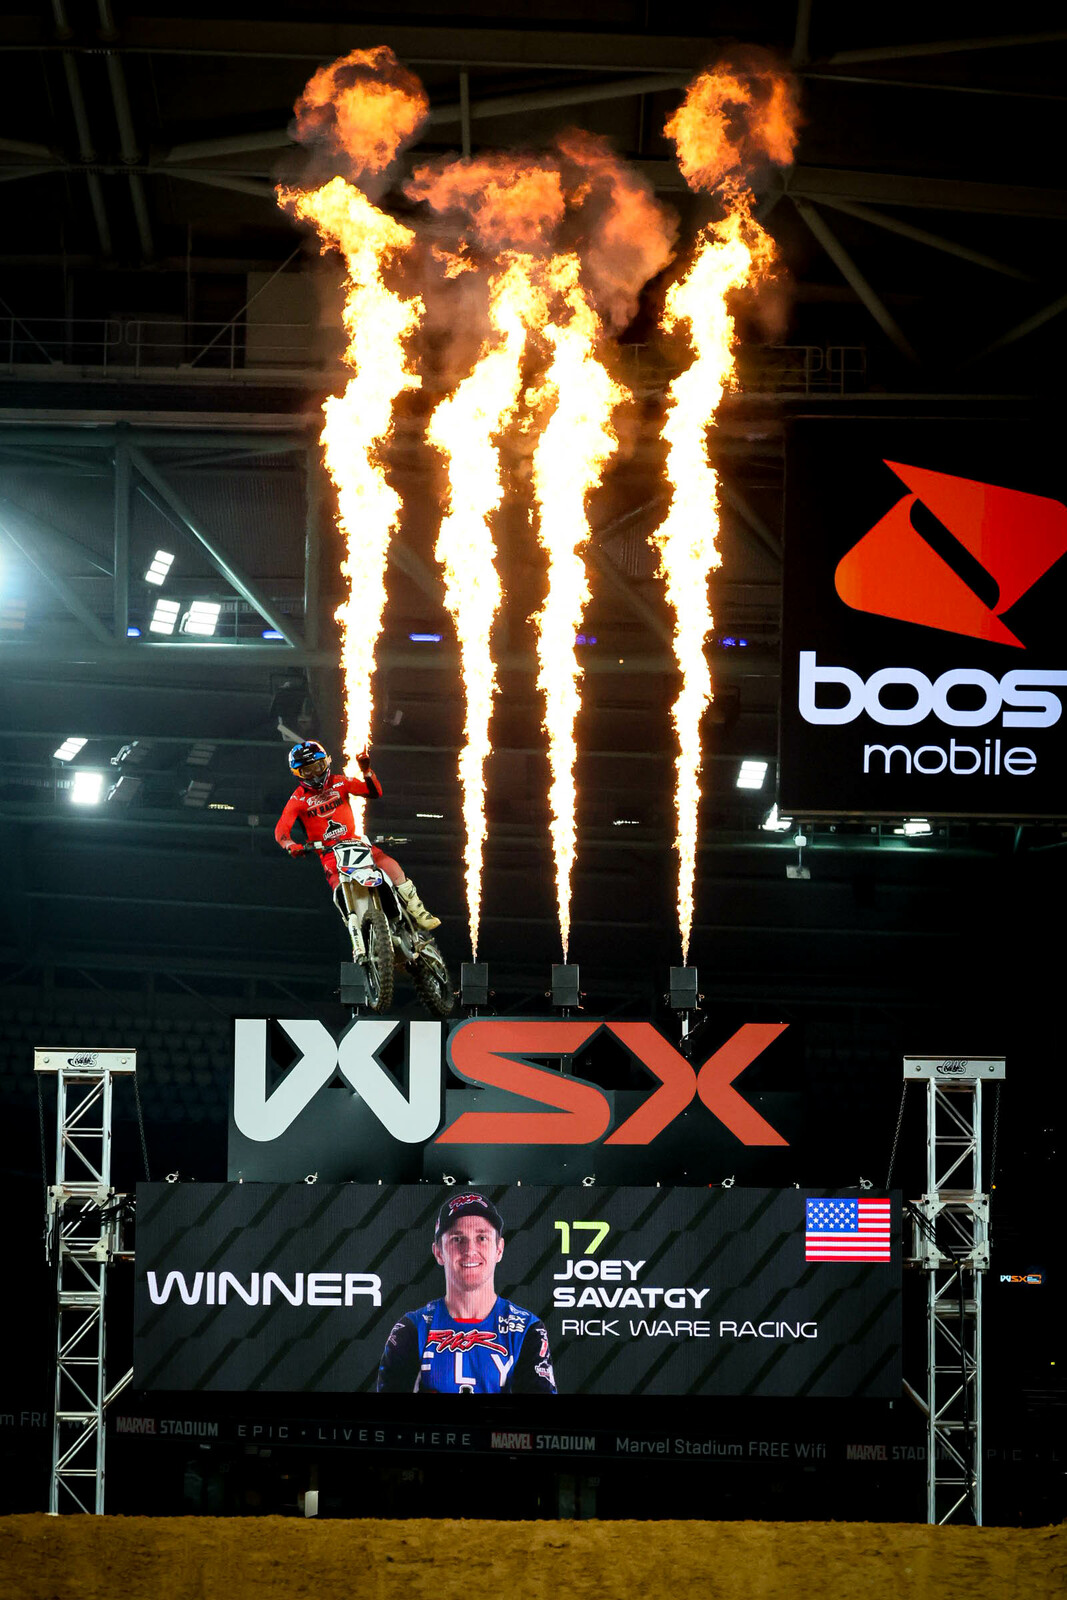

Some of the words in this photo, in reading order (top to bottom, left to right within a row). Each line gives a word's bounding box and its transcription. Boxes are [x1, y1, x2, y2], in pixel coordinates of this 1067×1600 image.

[864, 739, 1037, 775] mobile
[343, 849, 370, 866] 17
[234, 1018, 790, 1146] WSX
[554, 1221, 610, 1254] 17
[553, 1260, 646, 1280] JOEY
[147, 1271, 382, 1307] WINNER
[553, 1287, 710, 1308] SAVATGY
[562, 1319, 620, 1336] RICK
[630, 1320, 710, 1337] WARE
[719, 1321, 817, 1338] RACING
[116, 1416, 157, 1434] MARVEL
[160, 1420, 219, 1437] STADIUM
[237, 1424, 289, 1439] EPIC
[318, 1427, 385, 1442] LIVES
[414, 1431, 471, 1446] HERE
[491, 1432, 532, 1450] MARVEL
[536, 1434, 596, 1451] STADIUM
[616, 1437, 670, 1454] Marvel
[675, 1439, 743, 1457] Stadium
[748, 1441, 790, 1458] FREE
[795, 1442, 827, 1459] Wifi
[846, 1444, 888, 1461] MARVEL
